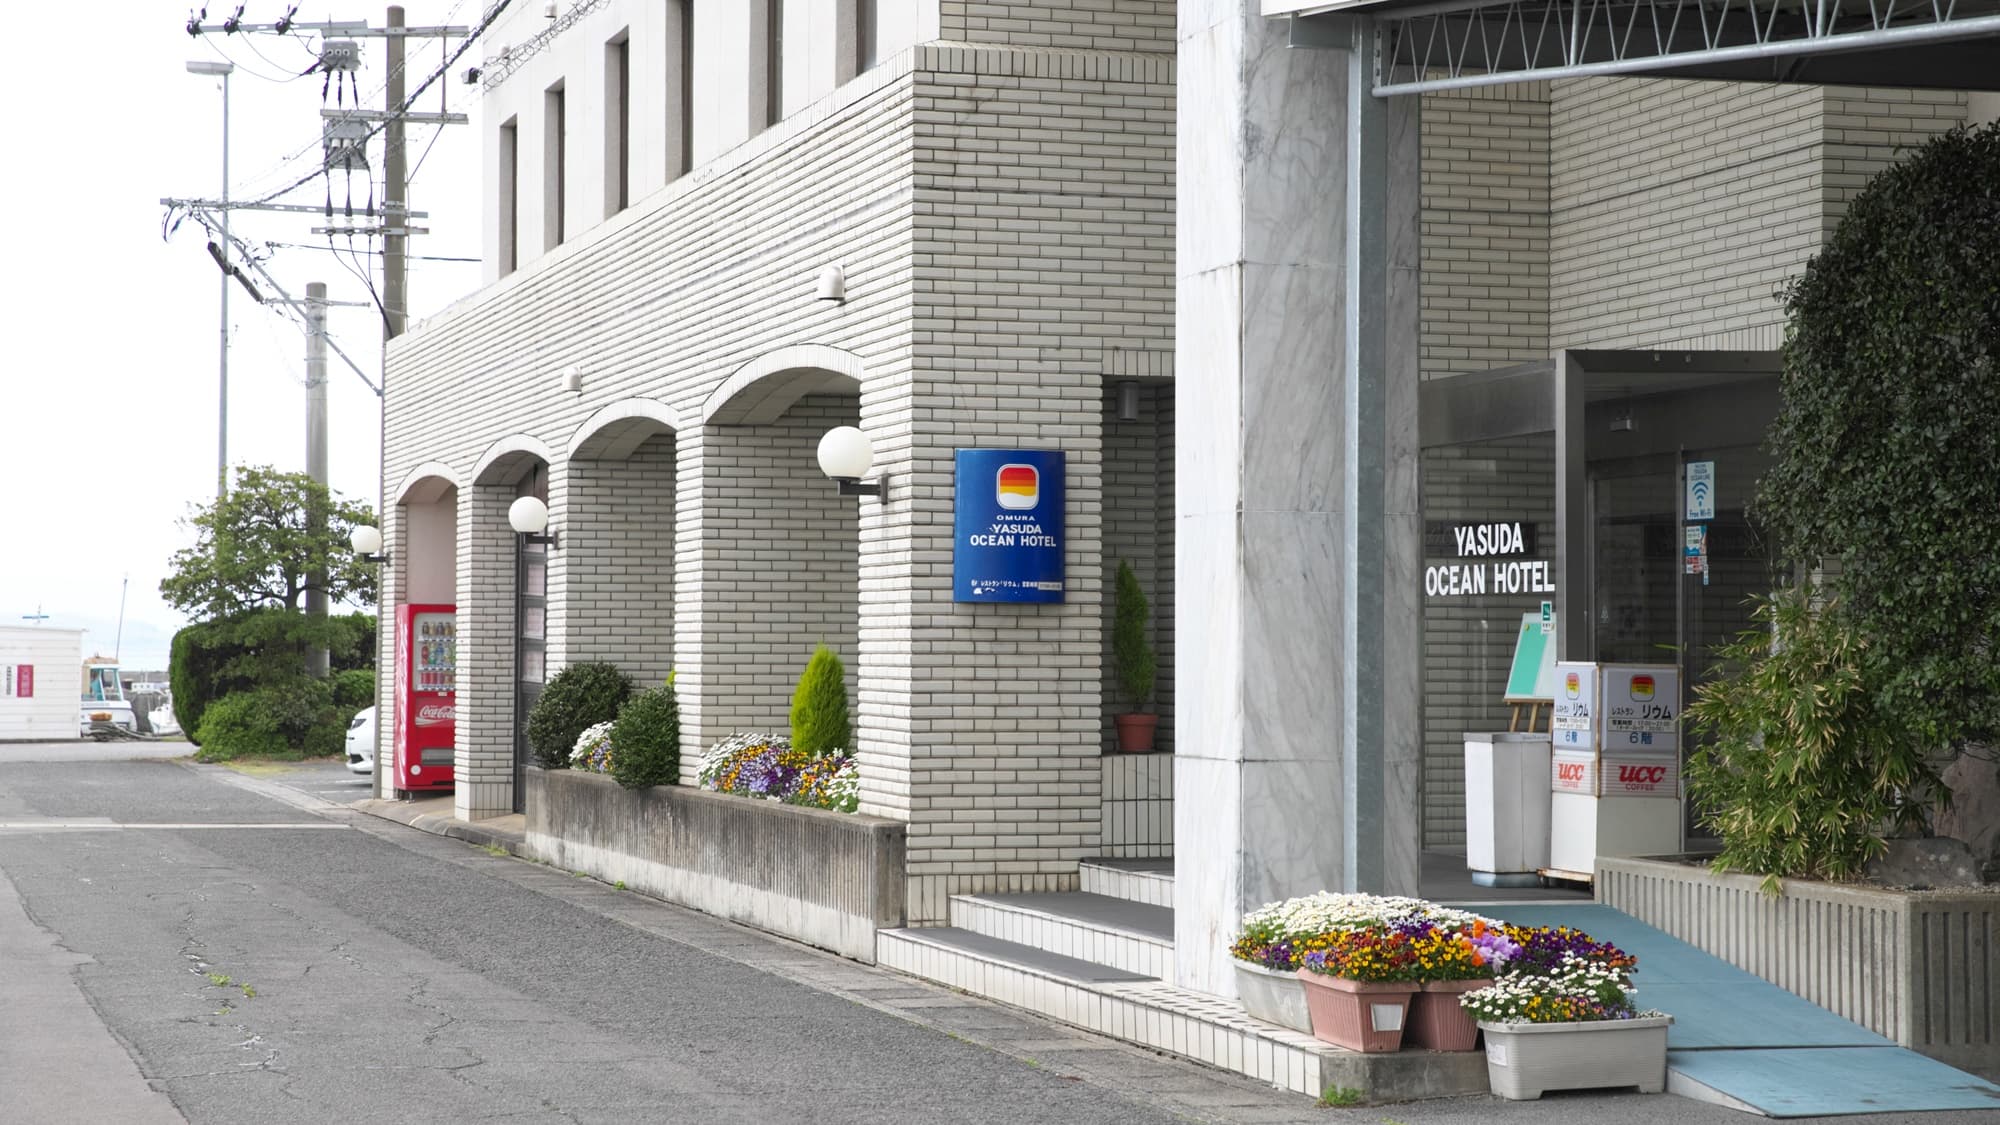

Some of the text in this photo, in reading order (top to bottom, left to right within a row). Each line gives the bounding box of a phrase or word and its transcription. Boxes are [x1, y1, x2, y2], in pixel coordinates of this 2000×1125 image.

[992, 524, 1042, 534] YASUDA
[970, 535, 1057, 547] OCEAN HOTEL
[1454, 522, 1524, 556] YASUDA
[1425, 560, 1556, 597] OCEAN HOTEL
[1642, 704, 1672, 720] リウム
[1558, 763, 1584, 781] UCC
[1618, 765, 1667, 784] UCC
[1625, 783, 1655, 791] COFFEE
